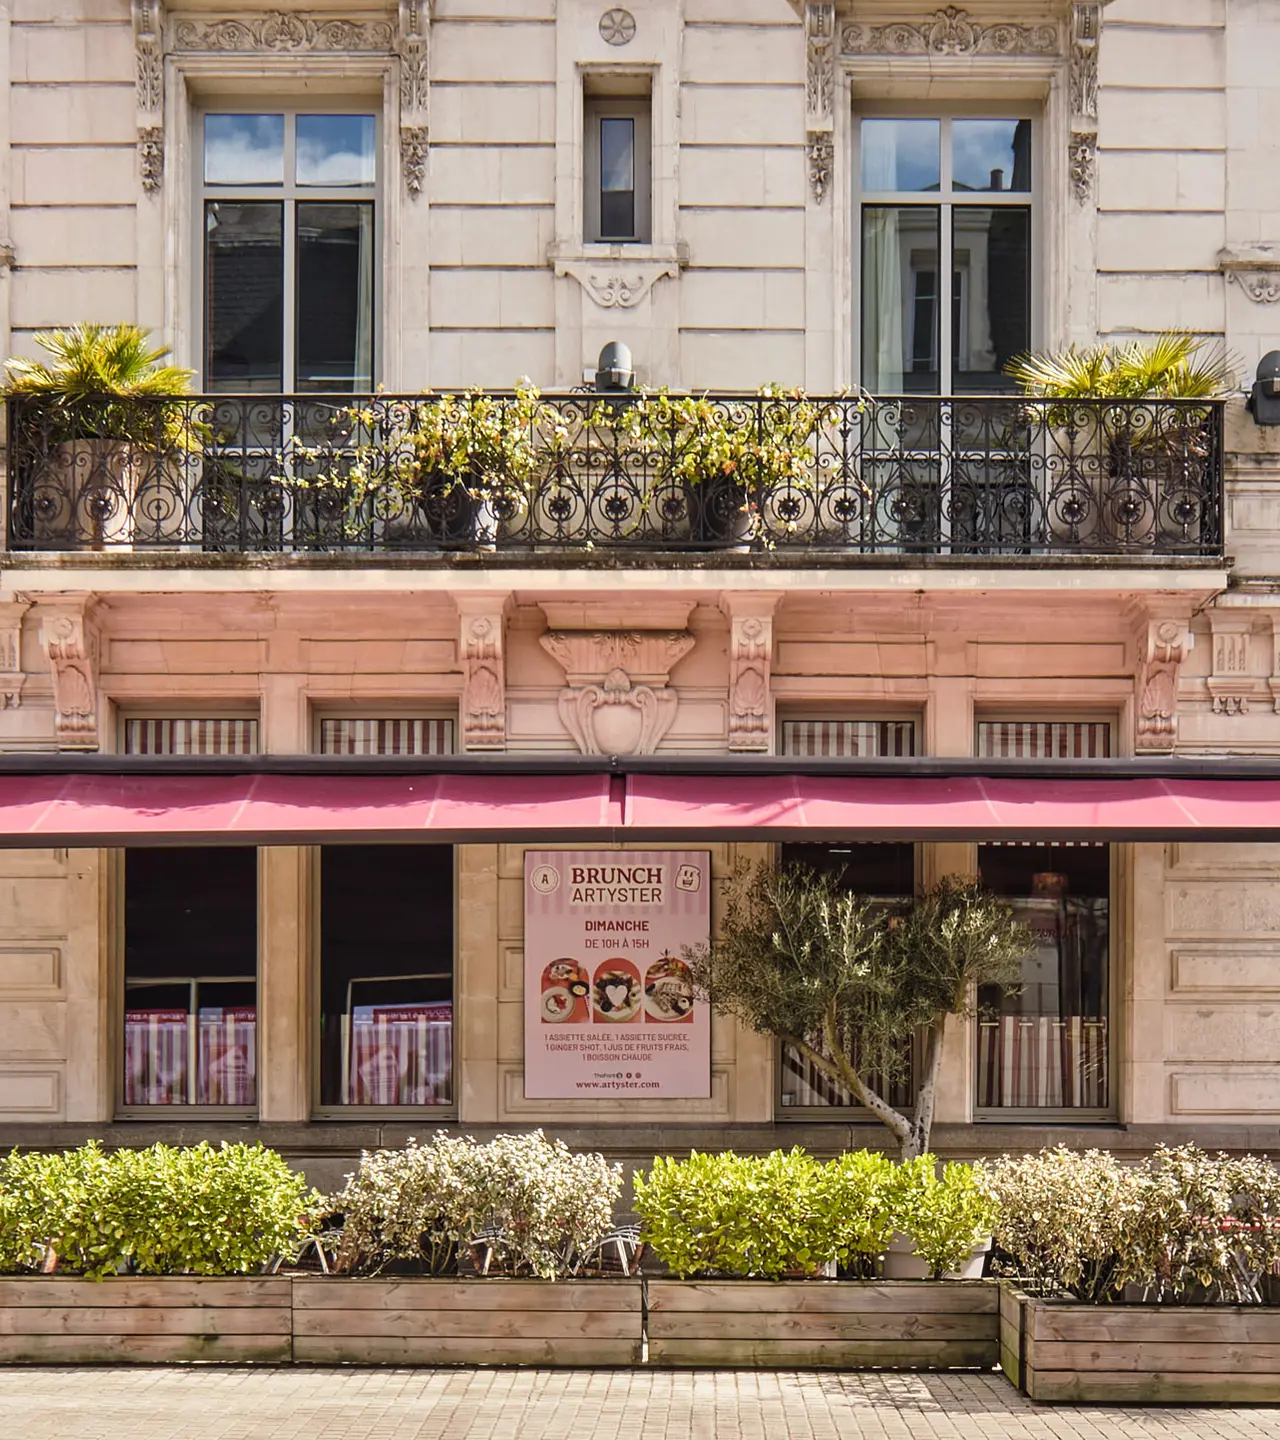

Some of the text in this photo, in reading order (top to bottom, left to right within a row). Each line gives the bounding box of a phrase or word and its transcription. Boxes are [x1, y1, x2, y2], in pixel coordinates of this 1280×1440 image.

[541, 873, 550, 885] A
[571, 867, 663, 884] BRUNCH
[572, 887, 662, 903] ARTYSTER
[585, 920, 650, 932] DIMANCHE
[585, 936, 650, 949] DE 10H À 15H
[549, 1034, 585, 1042] ASSIETTE
[620, 1034, 657, 1042] ASSIETTE
[575, 1081, 660, 1090] www.artyster.com
